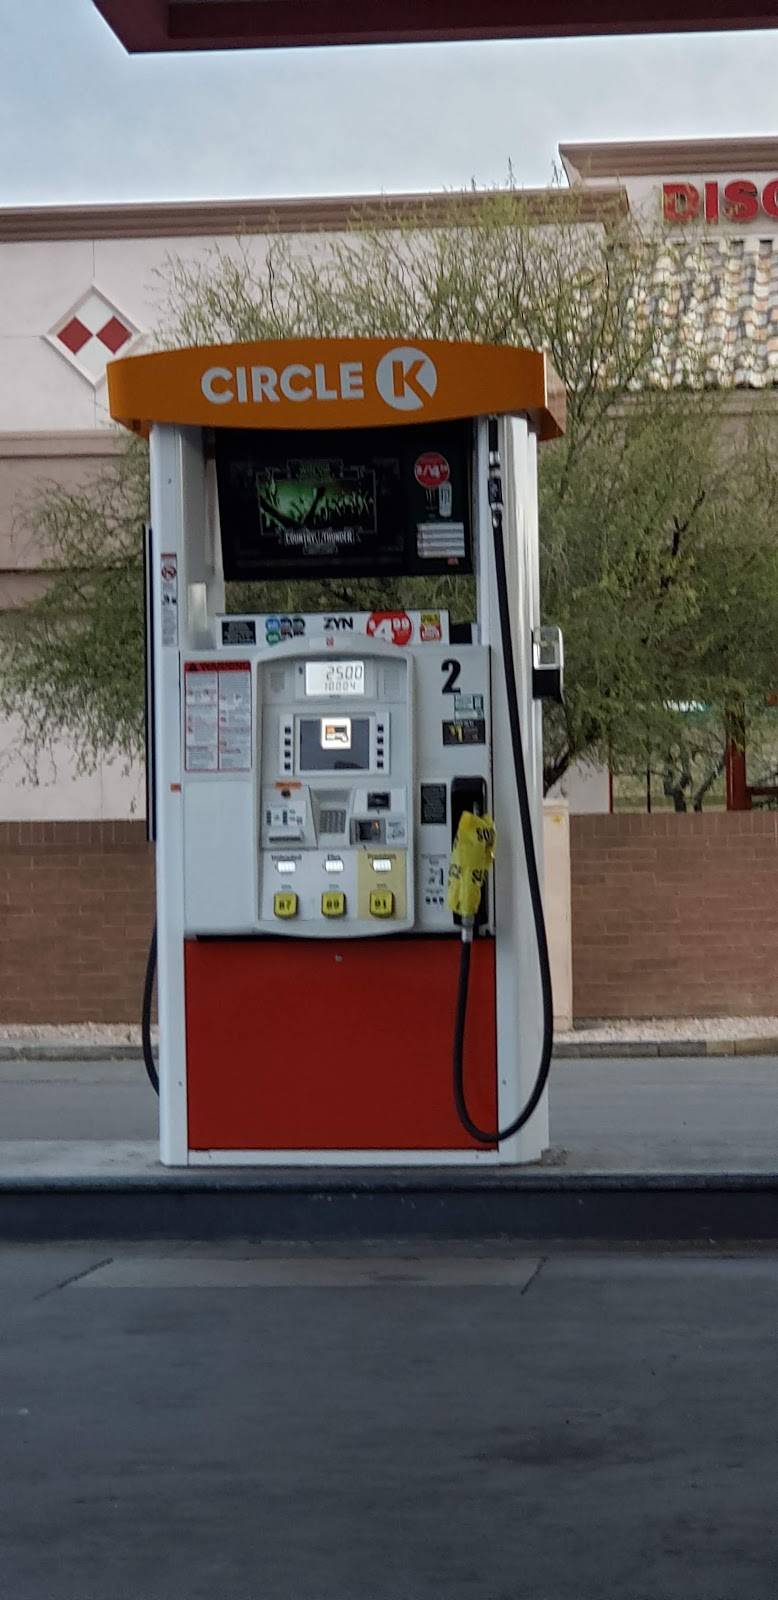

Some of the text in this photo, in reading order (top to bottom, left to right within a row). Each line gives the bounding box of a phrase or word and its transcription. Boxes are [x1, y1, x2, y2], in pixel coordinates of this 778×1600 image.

[201, 356, 437, 408] CIRCLE K
[323, 615, 354, 630] ZYN
[441, 658, 462, 694] 2
